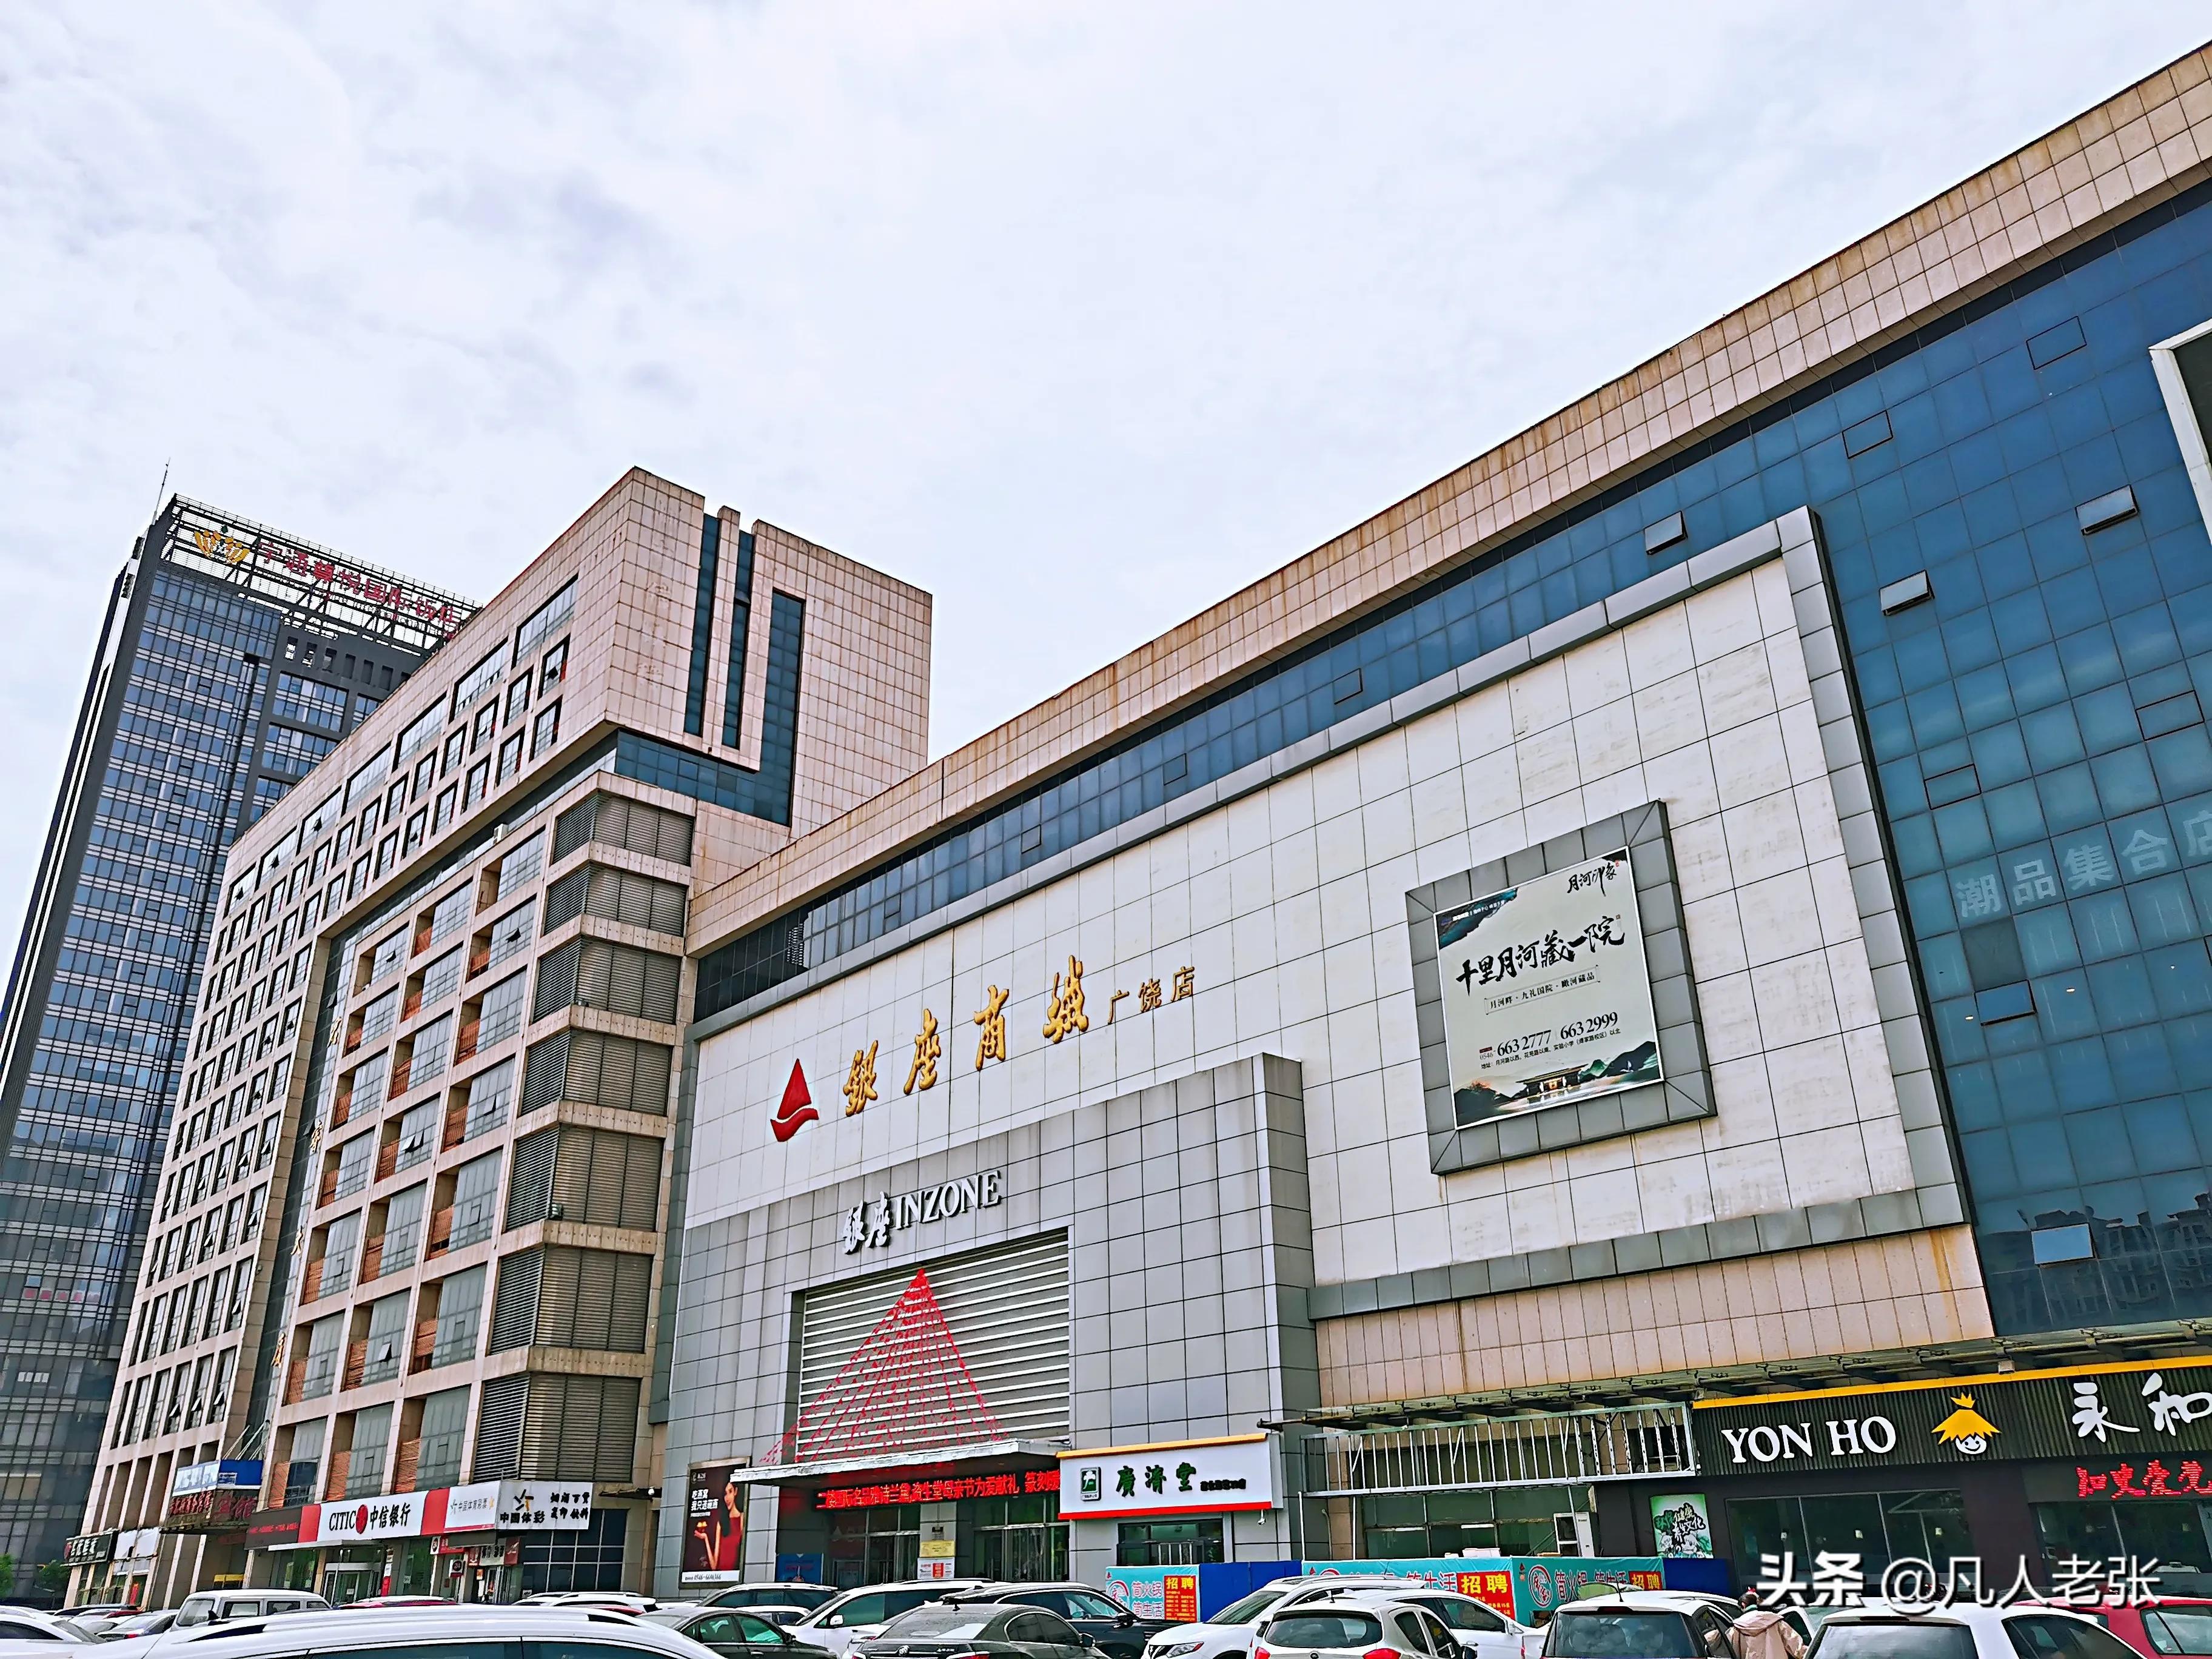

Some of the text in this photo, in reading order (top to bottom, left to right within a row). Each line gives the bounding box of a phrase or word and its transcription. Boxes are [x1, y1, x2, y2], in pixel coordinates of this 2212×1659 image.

[1956, 810, 2212, 917] 潮品集合店
[1107, 965, 1195, 1025] 广饶店
[894, 1170, 1002, 1230] INZONE
[2072, 1372, 2212, 1443] 永和
[1721, 1416, 1897, 1464] YON HO
[329, 1510, 357, 1532] CITIC
[370, 1502, 411, 1530] 中信银行
[500, 1510, 545, 1524] 中国体彩
[1165, 1577, 1194, 1590] 招聘
[1461, 1575, 1508, 1594] 招聘
[1631, 1574, 1660, 1590] 招聘
